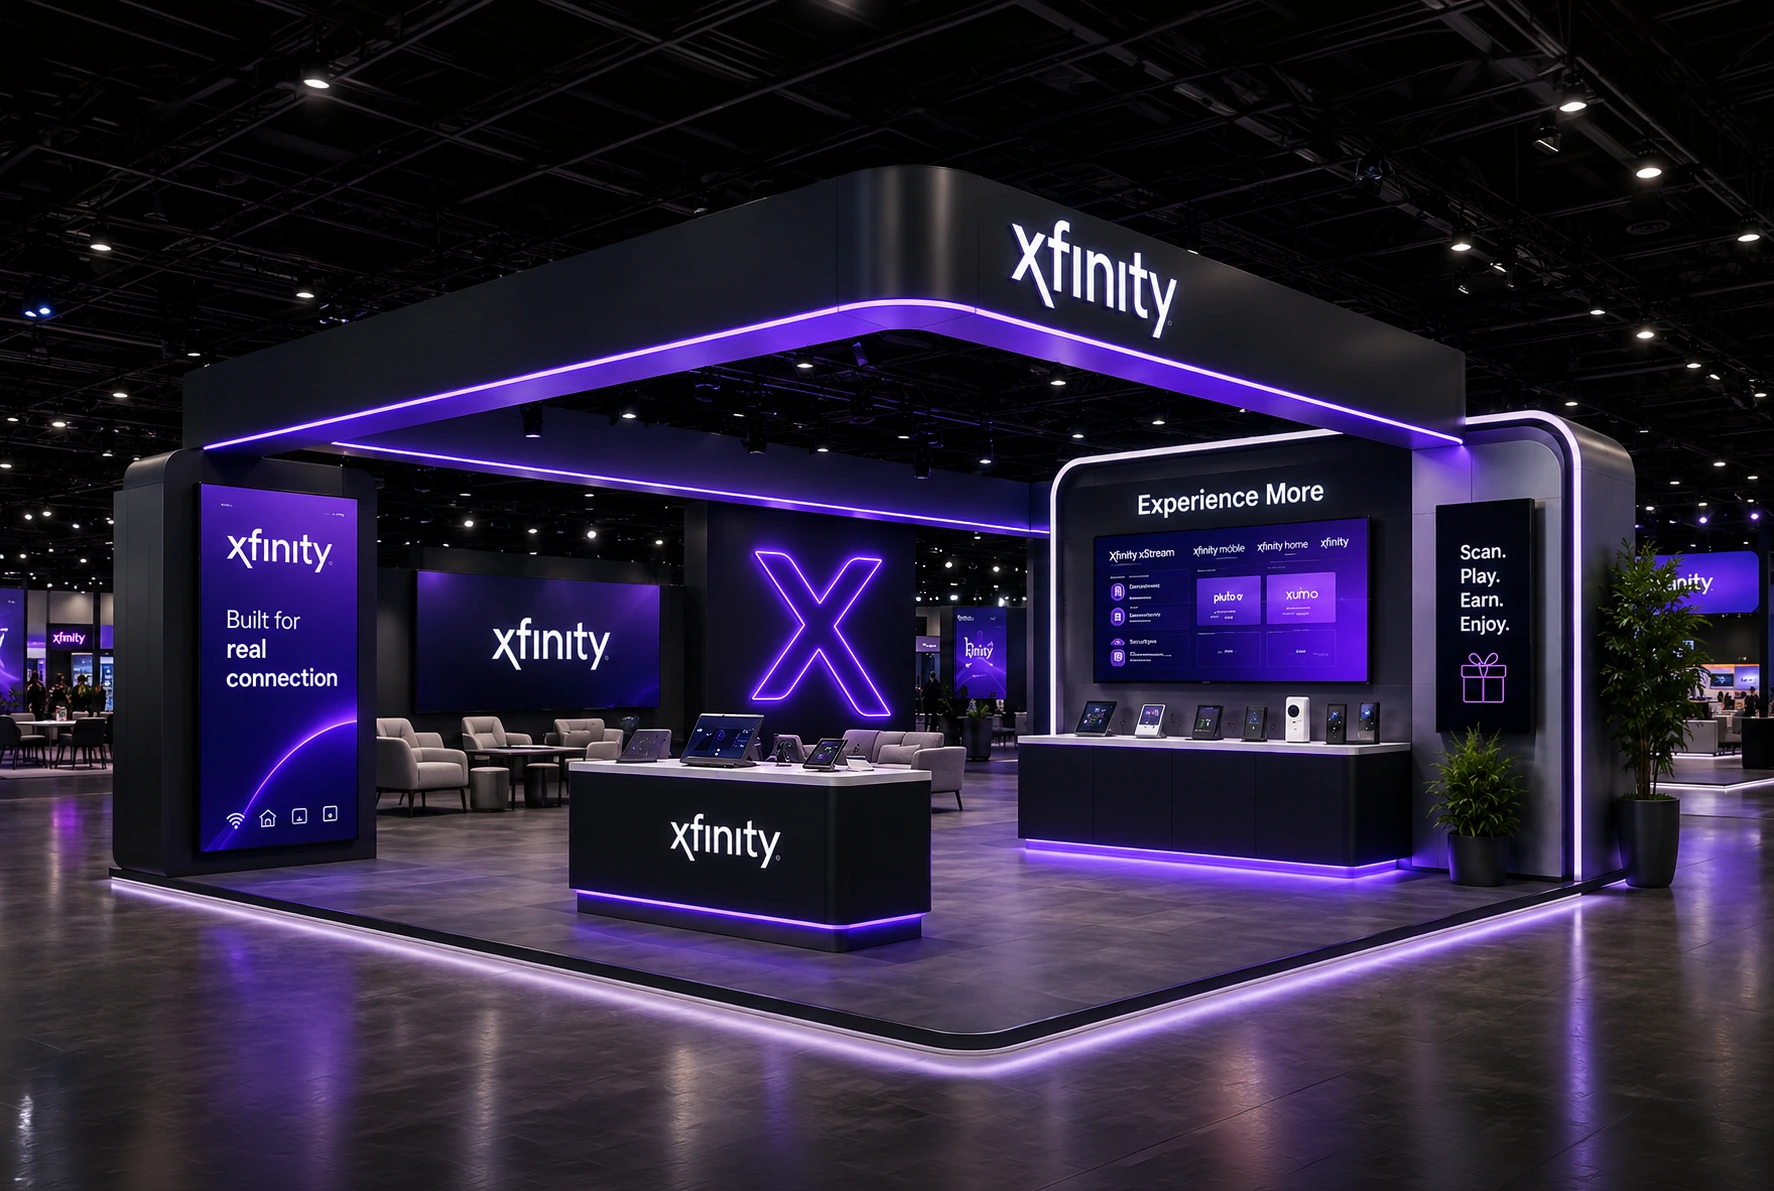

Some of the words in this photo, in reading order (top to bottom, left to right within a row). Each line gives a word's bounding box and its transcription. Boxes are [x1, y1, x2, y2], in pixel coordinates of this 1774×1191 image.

[1011, 220, 1178, 339] xfinity
[1137, 488, 1259, 519] Experience
[1266, 483, 1325, 507] More
[226, 528, 333, 573] xfinity
[1193, 545, 1218, 557] xfinity
[1257, 541, 1283, 553] xfinity
[1284, 540, 1309, 550] home
[1320, 536, 1350, 549] xfinity
[1460, 544, 1507, 561] Scan.
[1460, 567, 1501, 587] Play.
[1460, 592, 1504, 608] Earn.
[227, 609, 270, 629] Built
[274, 610, 301, 630] for
[1460, 615, 1510, 636] Enjoy.
[227, 638, 267, 659] real
[491, 617, 611, 671] xfinity
[226, 667, 338, 688] connection
[669, 813, 782, 869] xfinity
